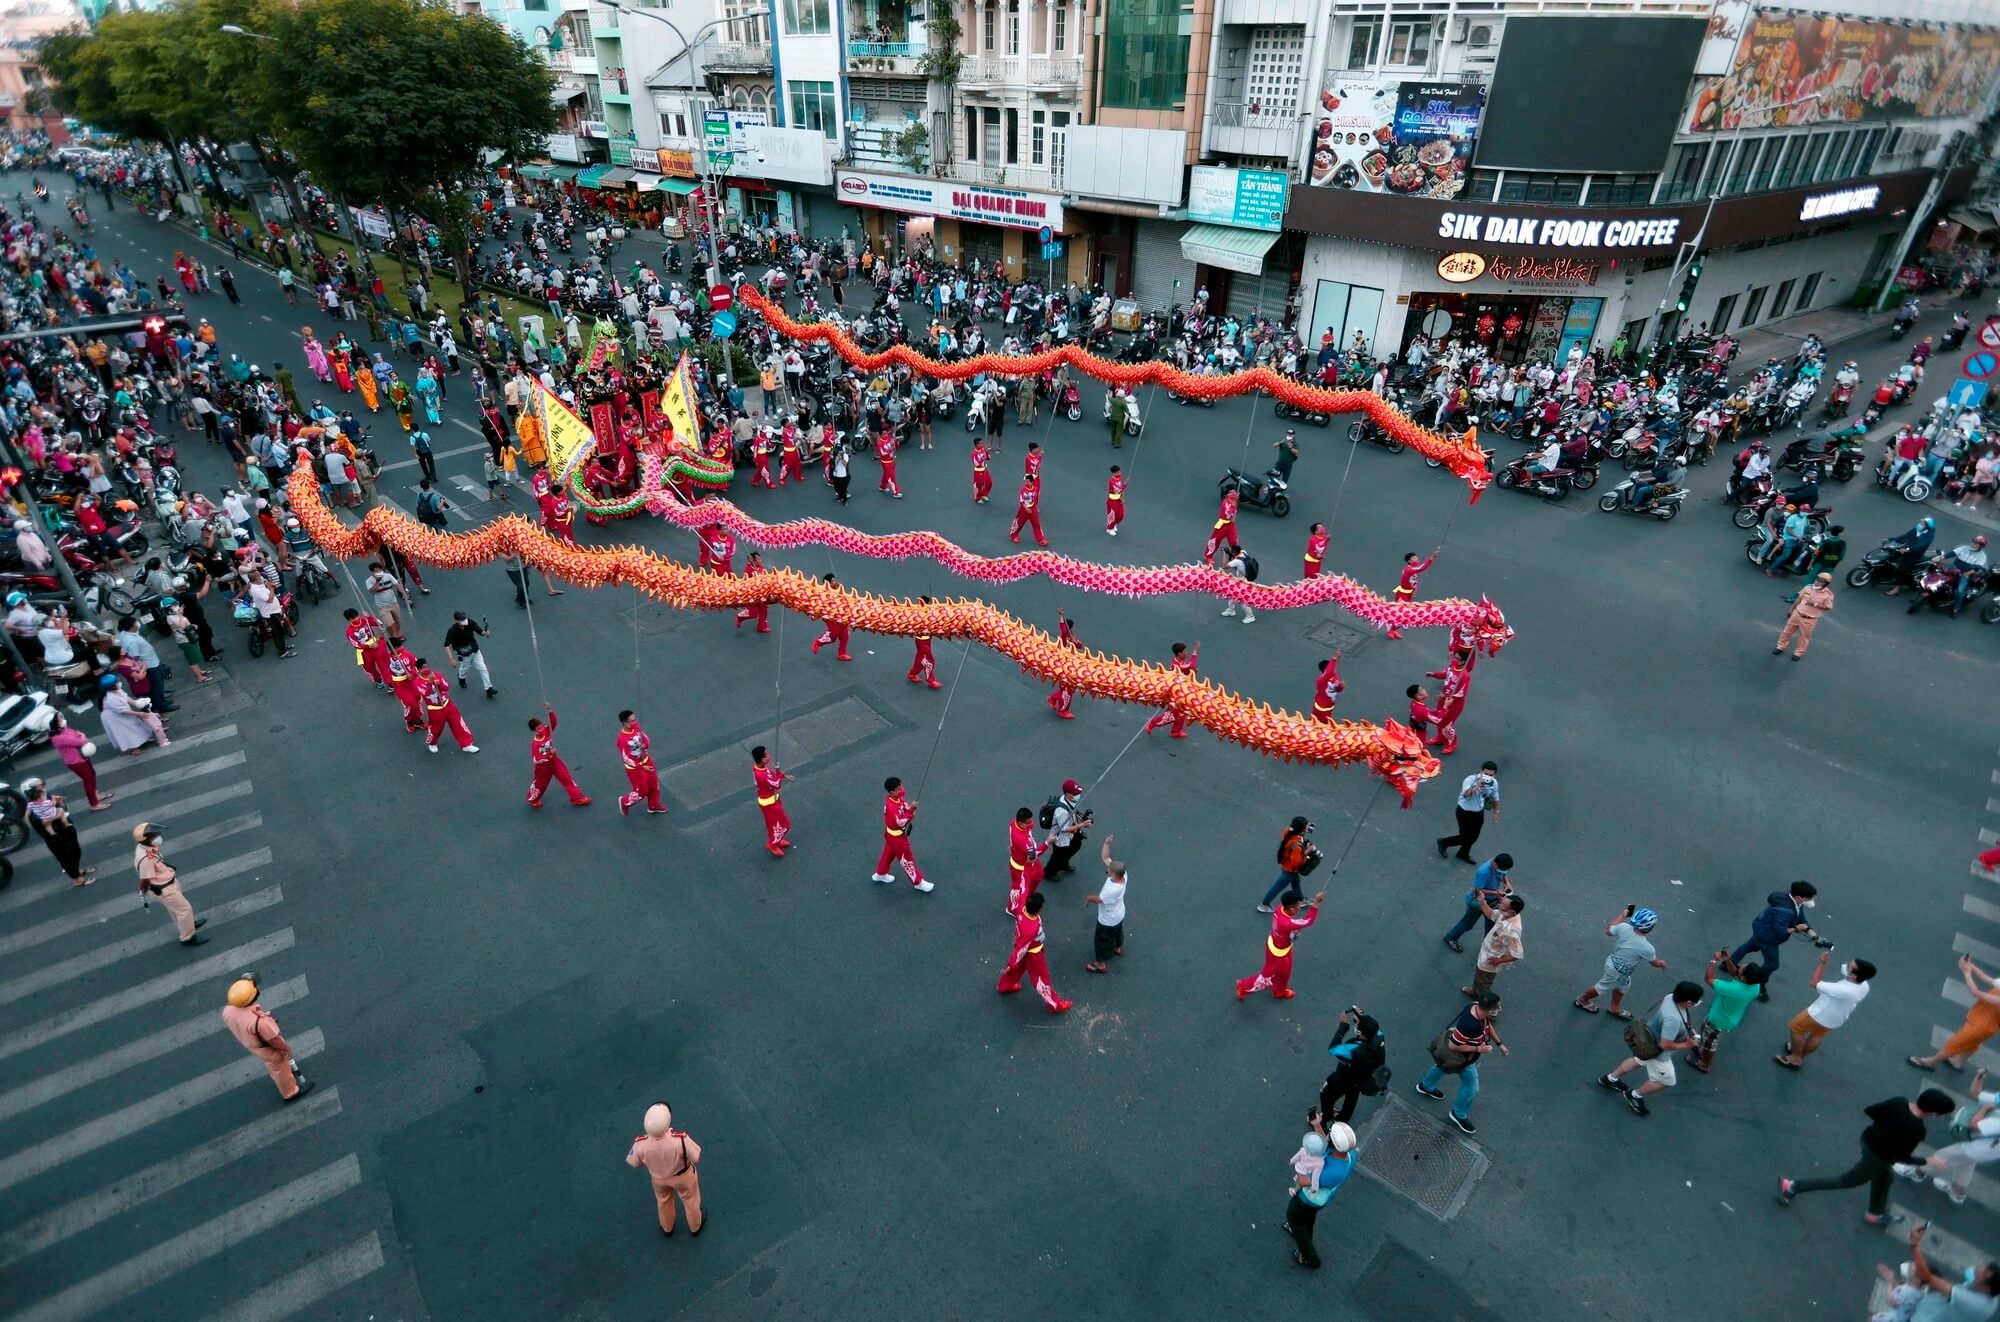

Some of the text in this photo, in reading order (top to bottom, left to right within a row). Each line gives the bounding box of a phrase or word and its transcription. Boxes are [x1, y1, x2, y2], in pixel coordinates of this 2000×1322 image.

[1431, 88, 1444, 96] Dak
[1444, 88, 1458, 97] Fook
[1427, 100, 1453, 113] SIK
[1334, 114, 1375, 129] DIMSUM
[952, 191, 972, 210] ĐẠI
[973, 193, 1013, 214] QUANG
[1015, 198, 1047, 219] MINH
[1438, 212, 1681, 247] SIK DAK FOOK COFFEE
